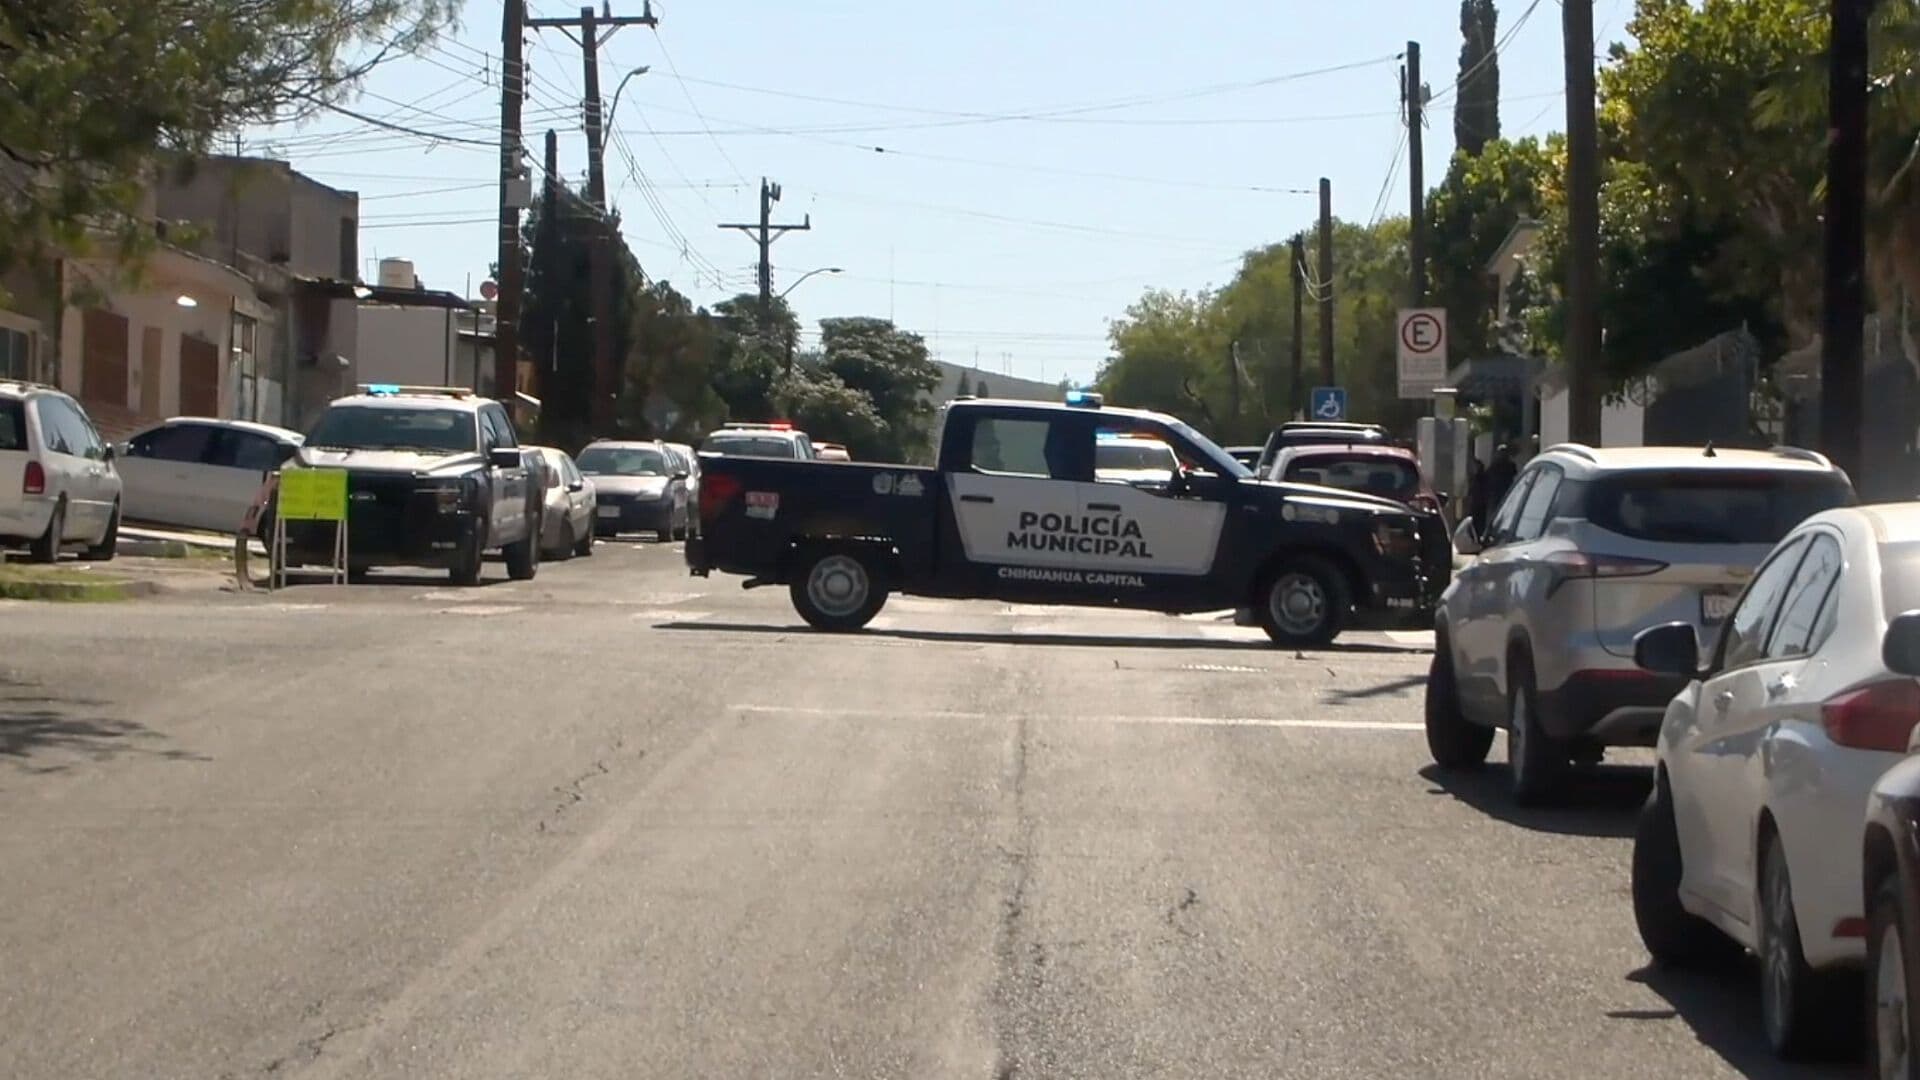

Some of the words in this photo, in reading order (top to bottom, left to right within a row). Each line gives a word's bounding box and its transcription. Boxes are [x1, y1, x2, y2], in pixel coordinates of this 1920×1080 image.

[1413, 321, 1430, 345] E
[1019, 511, 1143, 539] POLICÍA
[1007, 531, 1153, 558] MUNICIPAL
[998, 567, 1083, 583] CHIHUAHUA
[1086, 573, 1145, 587] CAPITAL
